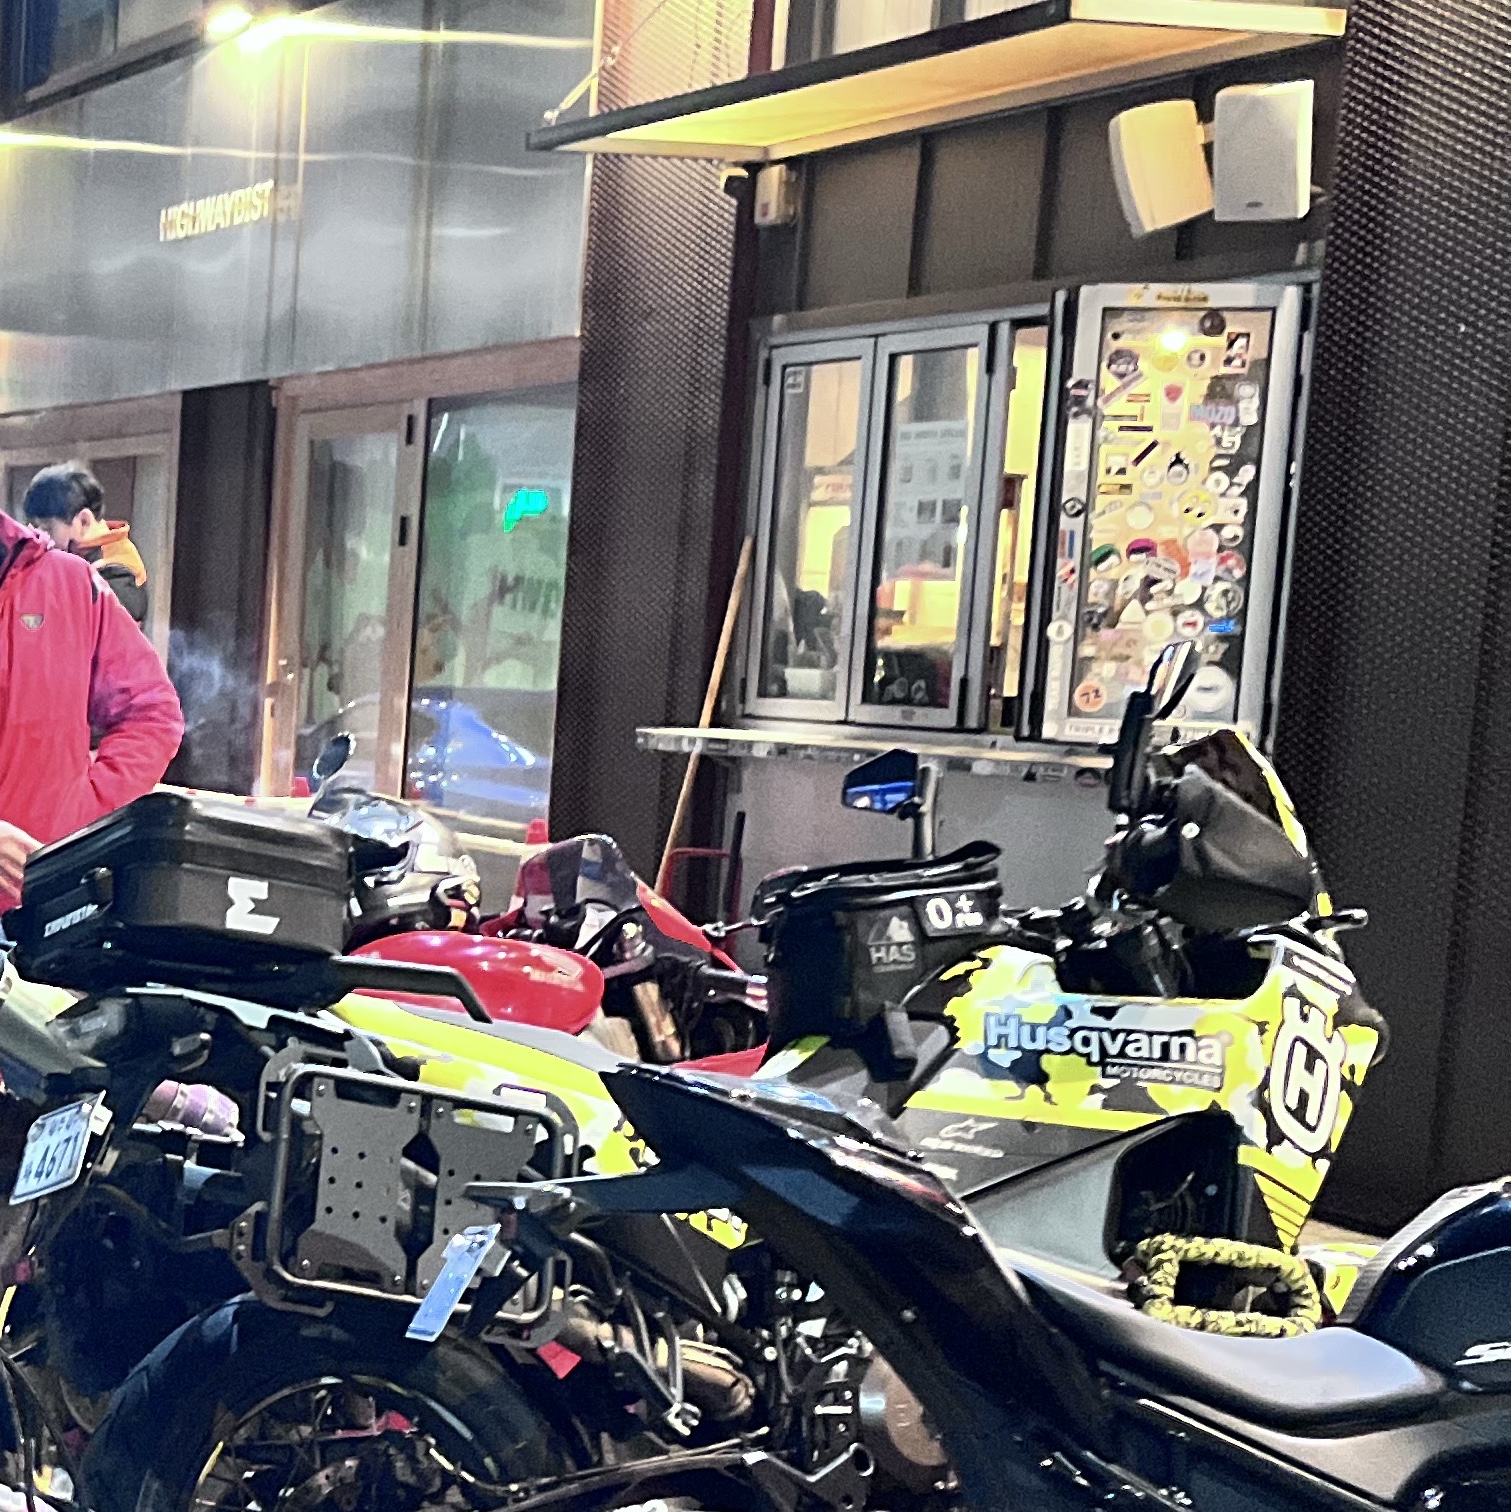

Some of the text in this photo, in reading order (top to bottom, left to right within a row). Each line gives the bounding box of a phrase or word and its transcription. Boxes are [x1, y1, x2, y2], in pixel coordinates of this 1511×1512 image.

[869, 943, 917, 965] HAS
[986, 1012, 1224, 1067] Husqvarna
[1105, 1065, 1223, 1090] MOTORCYCLES
